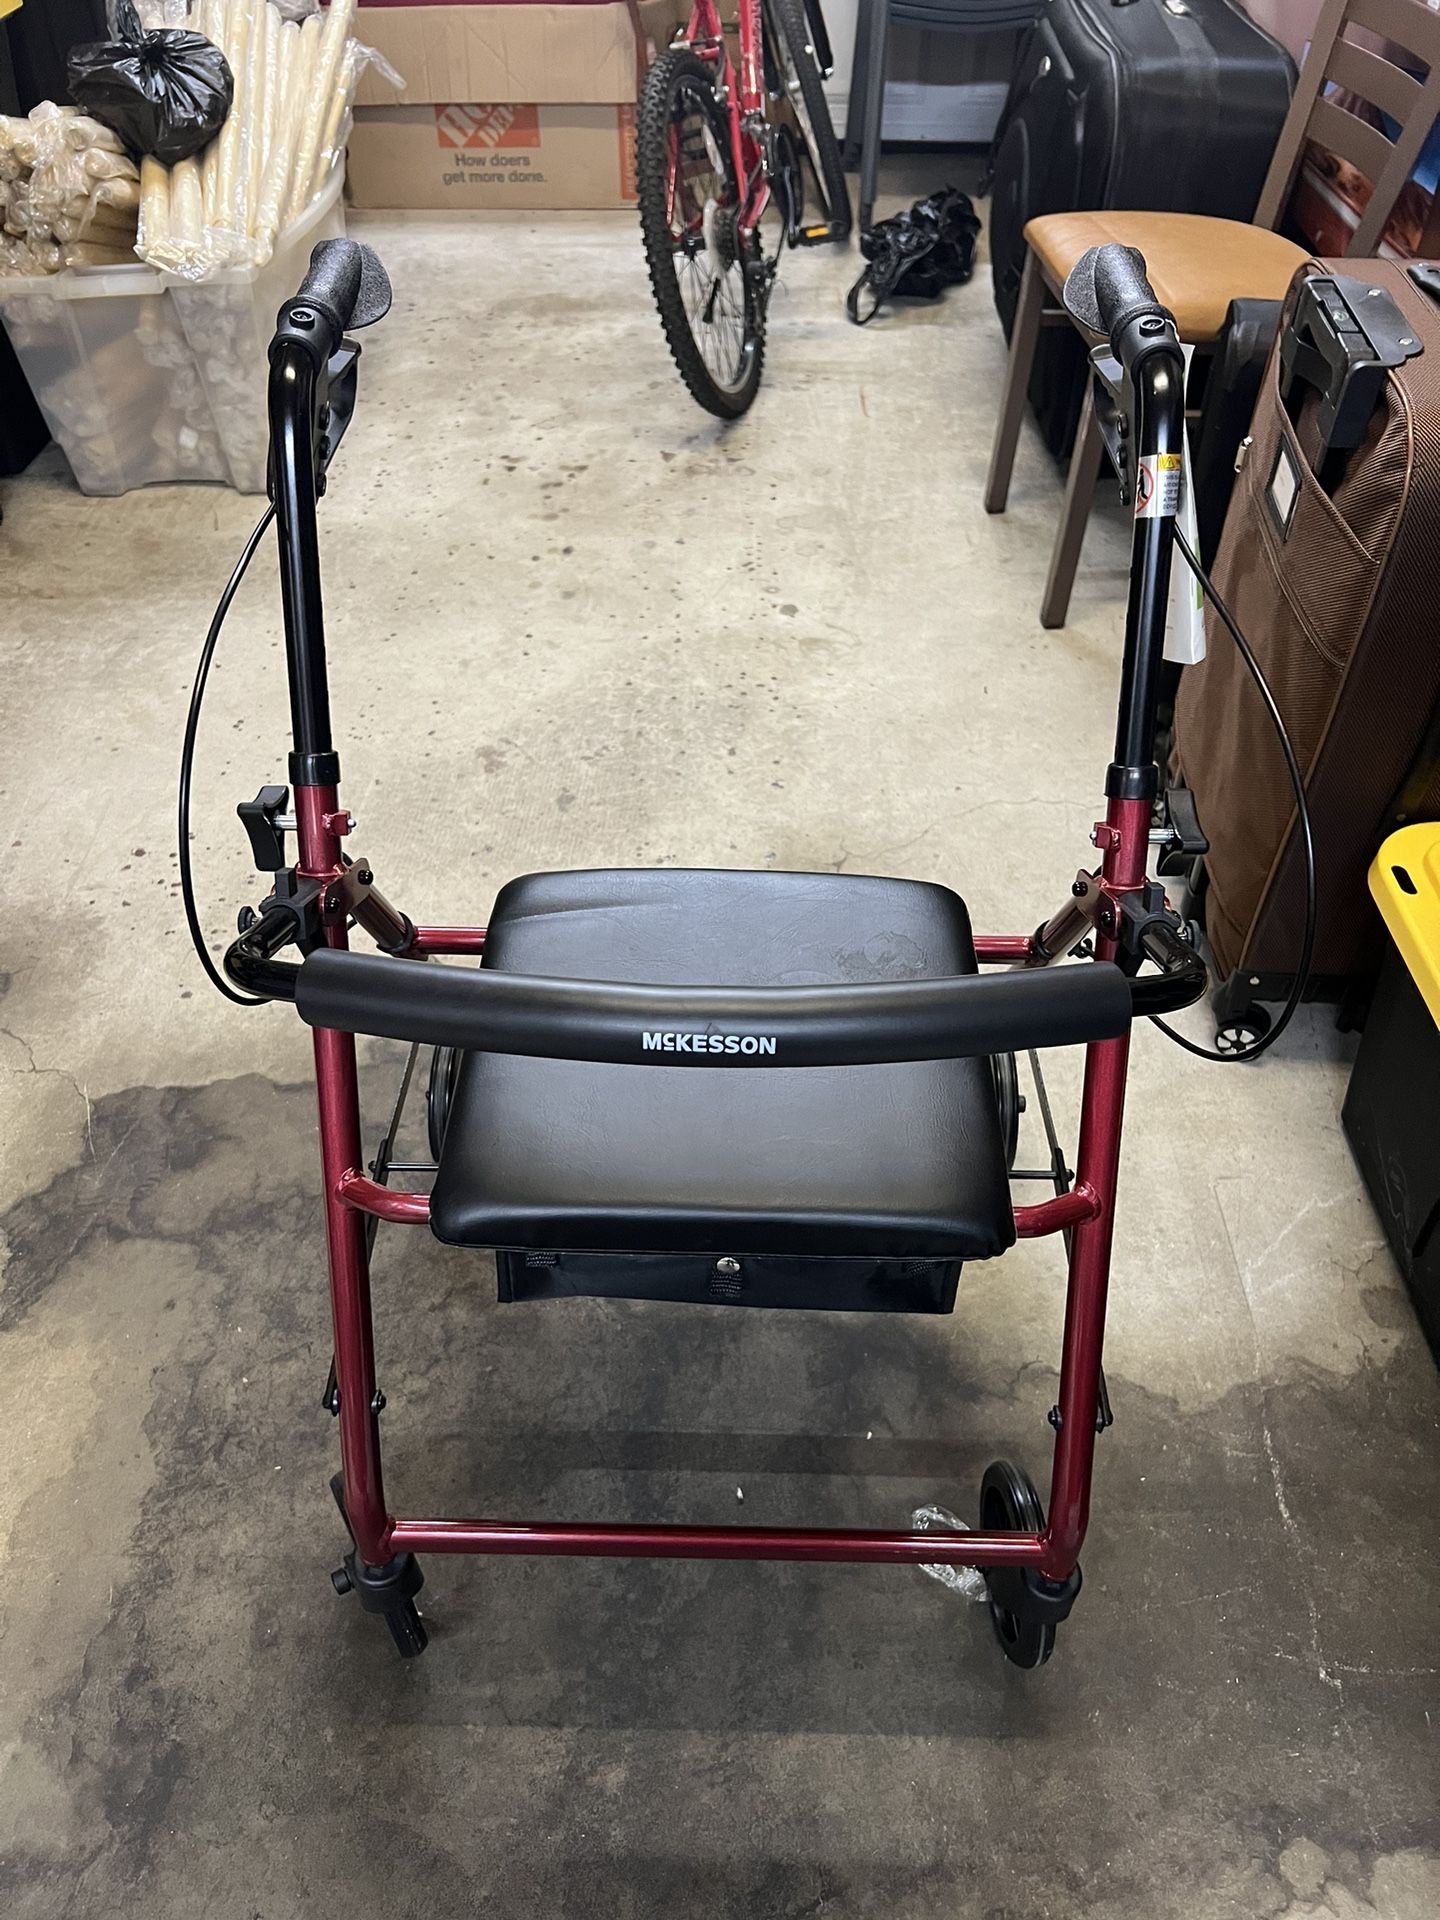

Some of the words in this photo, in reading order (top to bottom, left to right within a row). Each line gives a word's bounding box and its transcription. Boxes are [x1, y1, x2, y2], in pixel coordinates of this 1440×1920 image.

[455, 153, 486, 167] How
[490, 153, 530, 167] doers
[442, 170, 466, 185] get
[469, 172, 504, 184] more
[508, 170, 548, 184] done.
